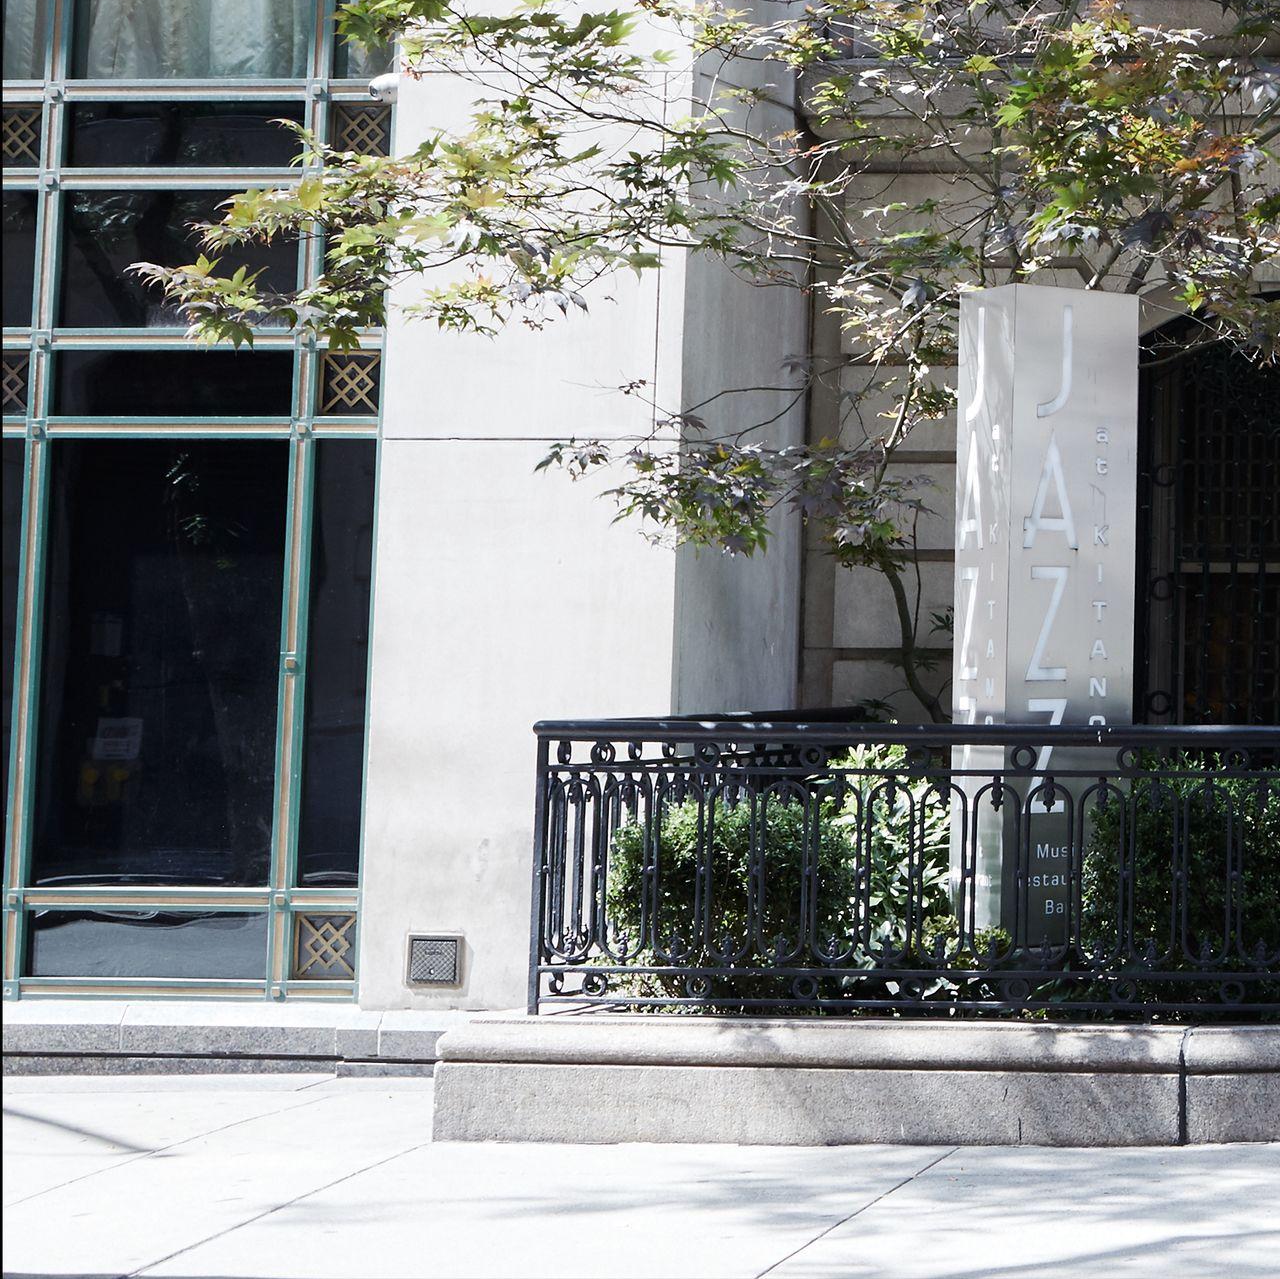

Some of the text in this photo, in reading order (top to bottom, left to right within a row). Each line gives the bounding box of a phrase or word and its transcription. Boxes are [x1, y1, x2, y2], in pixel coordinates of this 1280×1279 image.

[1096, 427, 1109, 475] at
[1022, 305, 1079, 814] JAZZ
[1036, 843, 1084, 858] Musi
[1044, 899, 1073, 915] Ba
